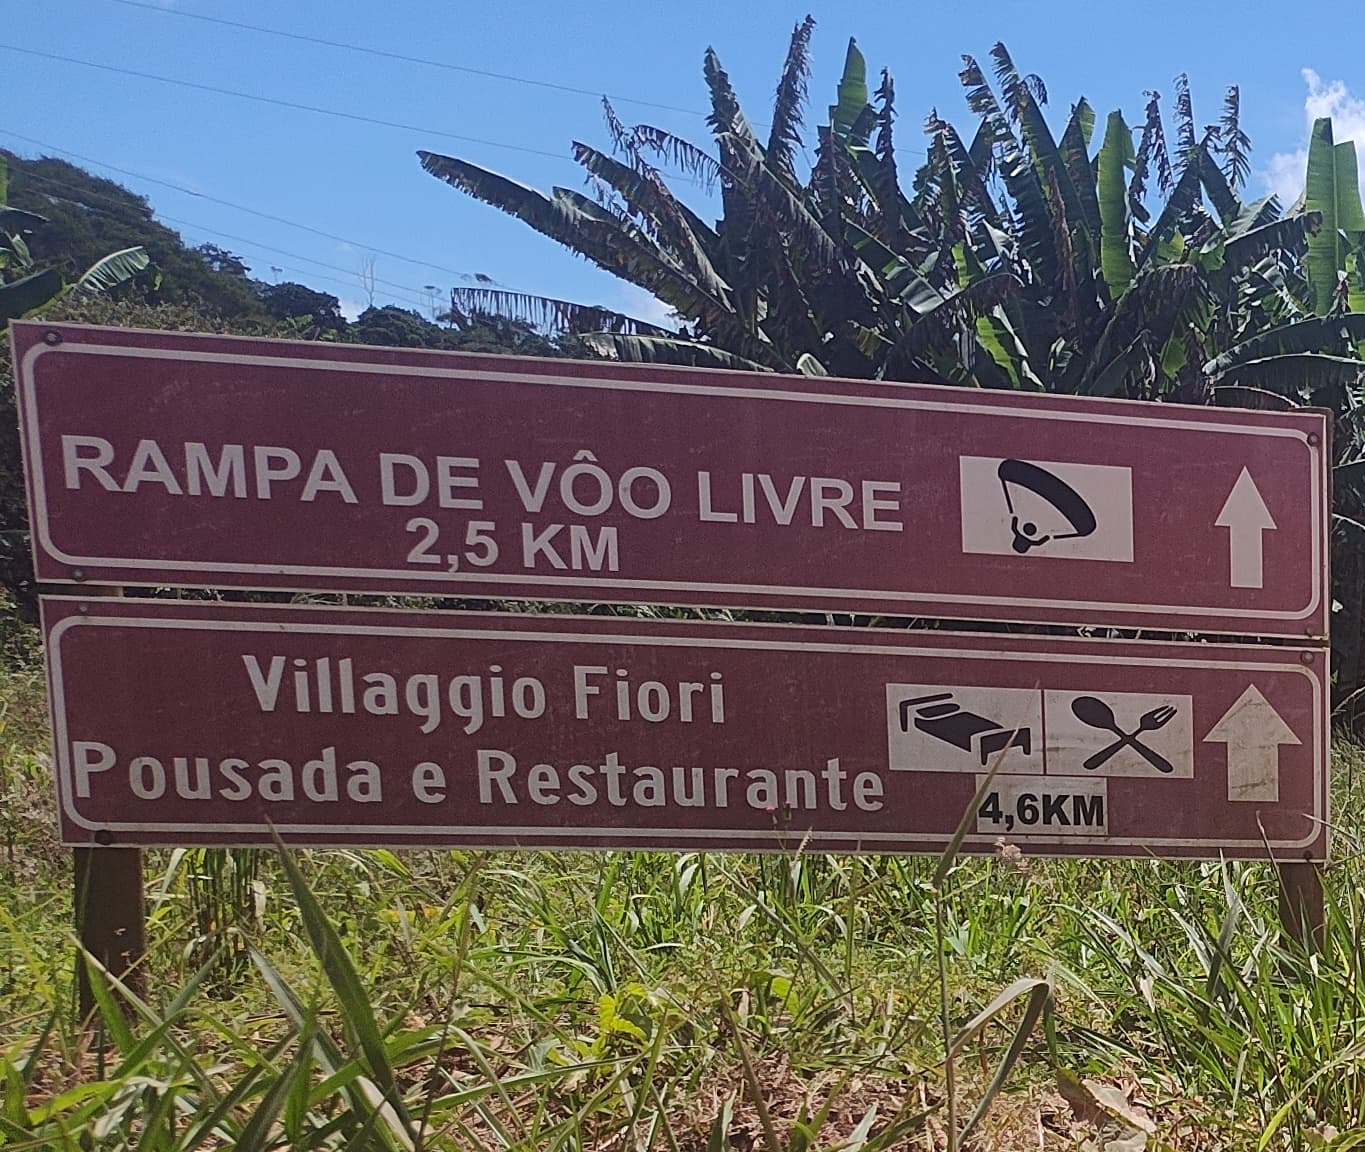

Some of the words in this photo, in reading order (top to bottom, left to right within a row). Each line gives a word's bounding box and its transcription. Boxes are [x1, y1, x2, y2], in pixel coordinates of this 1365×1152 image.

[61, 434, 359, 505] RAMPA
[379, 453, 484, 510] DE
[504, 449, 672, 519] VÔO
[697, 470, 905, 532] LIVRE
[405, 517, 499, 573] 2,5
[521, 522, 620, 572] KM
[242, 654, 547, 736] Villaggio
[572, 665, 725, 724] Fiori
[71, 740, 383, 803] Pousada
[412, 761, 448, 804] e
[476, 749, 885, 812] Restaurante
[978, 791, 1105, 832] 4,6KM
